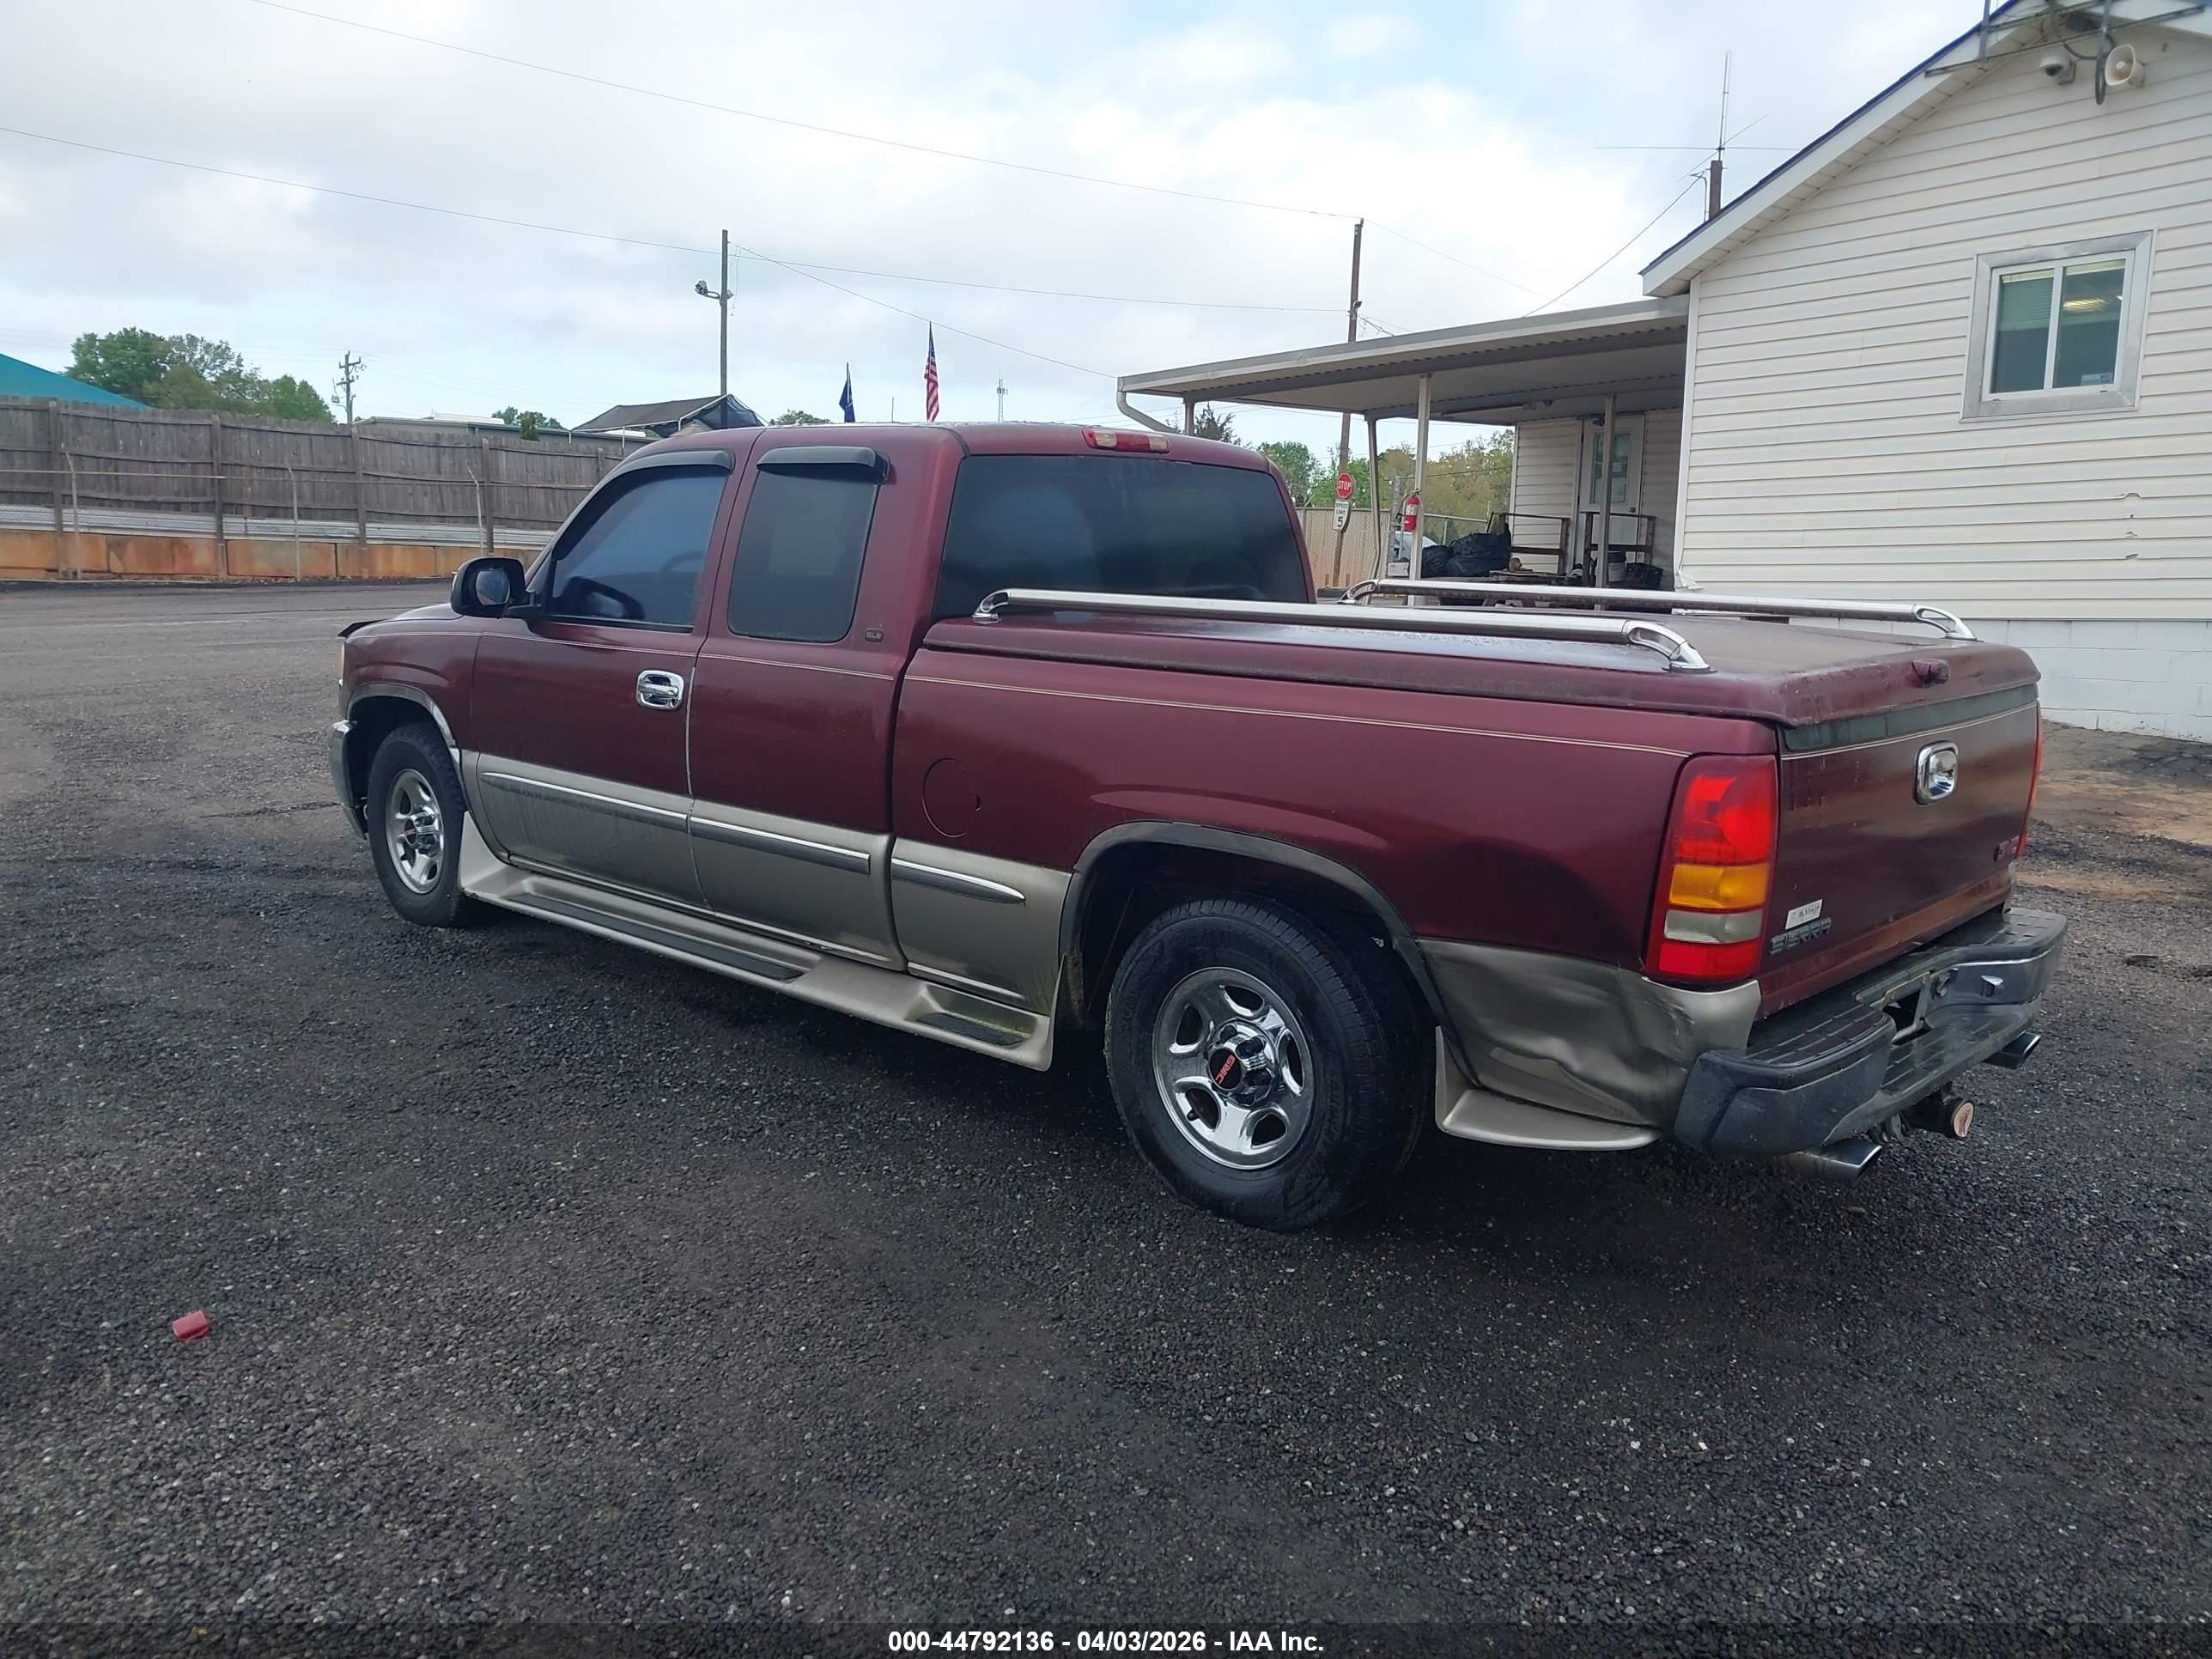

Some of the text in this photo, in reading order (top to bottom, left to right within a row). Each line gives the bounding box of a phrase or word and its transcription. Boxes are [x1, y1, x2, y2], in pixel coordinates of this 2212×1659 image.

[1338, 480, 1352, 490] STOP
[1337, 516, 1344, 528] 5
[1771, 917, 1832, 955] SIERRA
[1215, 1054, 1236, 1085] GMC
